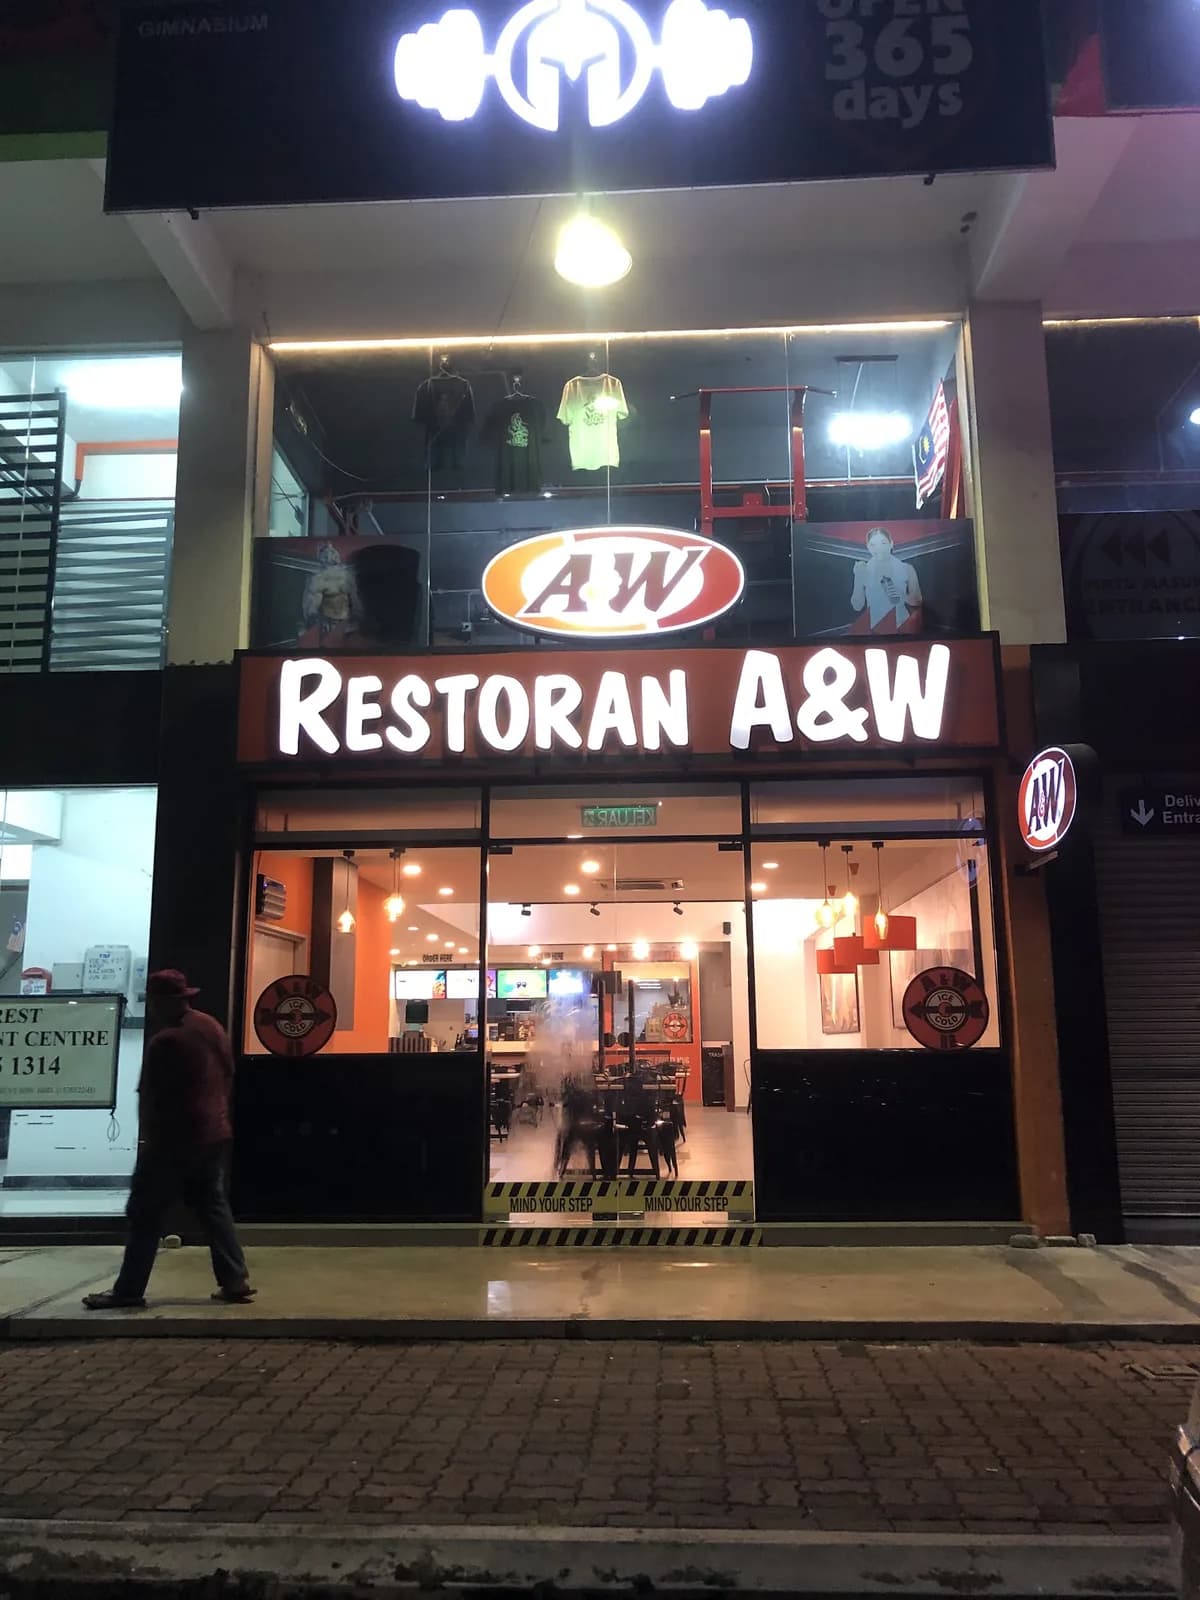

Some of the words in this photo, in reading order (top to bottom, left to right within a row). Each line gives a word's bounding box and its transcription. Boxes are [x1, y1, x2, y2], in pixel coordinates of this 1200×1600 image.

[138, 13, 268, 37] GIMNASIUM
[824, 15, 974, 80] 365
[832, 80, 963, 128] days
[524, 549, 705, 613] AW
[279, 657, 689, 756] RESTORAN
[730, 643, 950, 750] A&W
[1028, 762, 1064, 836] A&W
[289, 1001, 304, 1009] ICE
[938, 994, 954, 1002] ICE
[0, 1008, 43, 1024] EST
[935, 1015, 958, 1025] COLD
[284, 1022, 305, 1032] COLD
[25, 1031, 109, 1047] CENTRE
[12, 1055, 61, 1076] 1314
[510, 1197, 537, 1212] MIND
[538, 1197, 566, 1212] YOUR
[568, 1197, 593, 1211] STEP
[644, 1197, 672, 1212] MIND
[674, 1197, 702, 1211] YOUR
[704, 1196, 729, 1211] STEP
